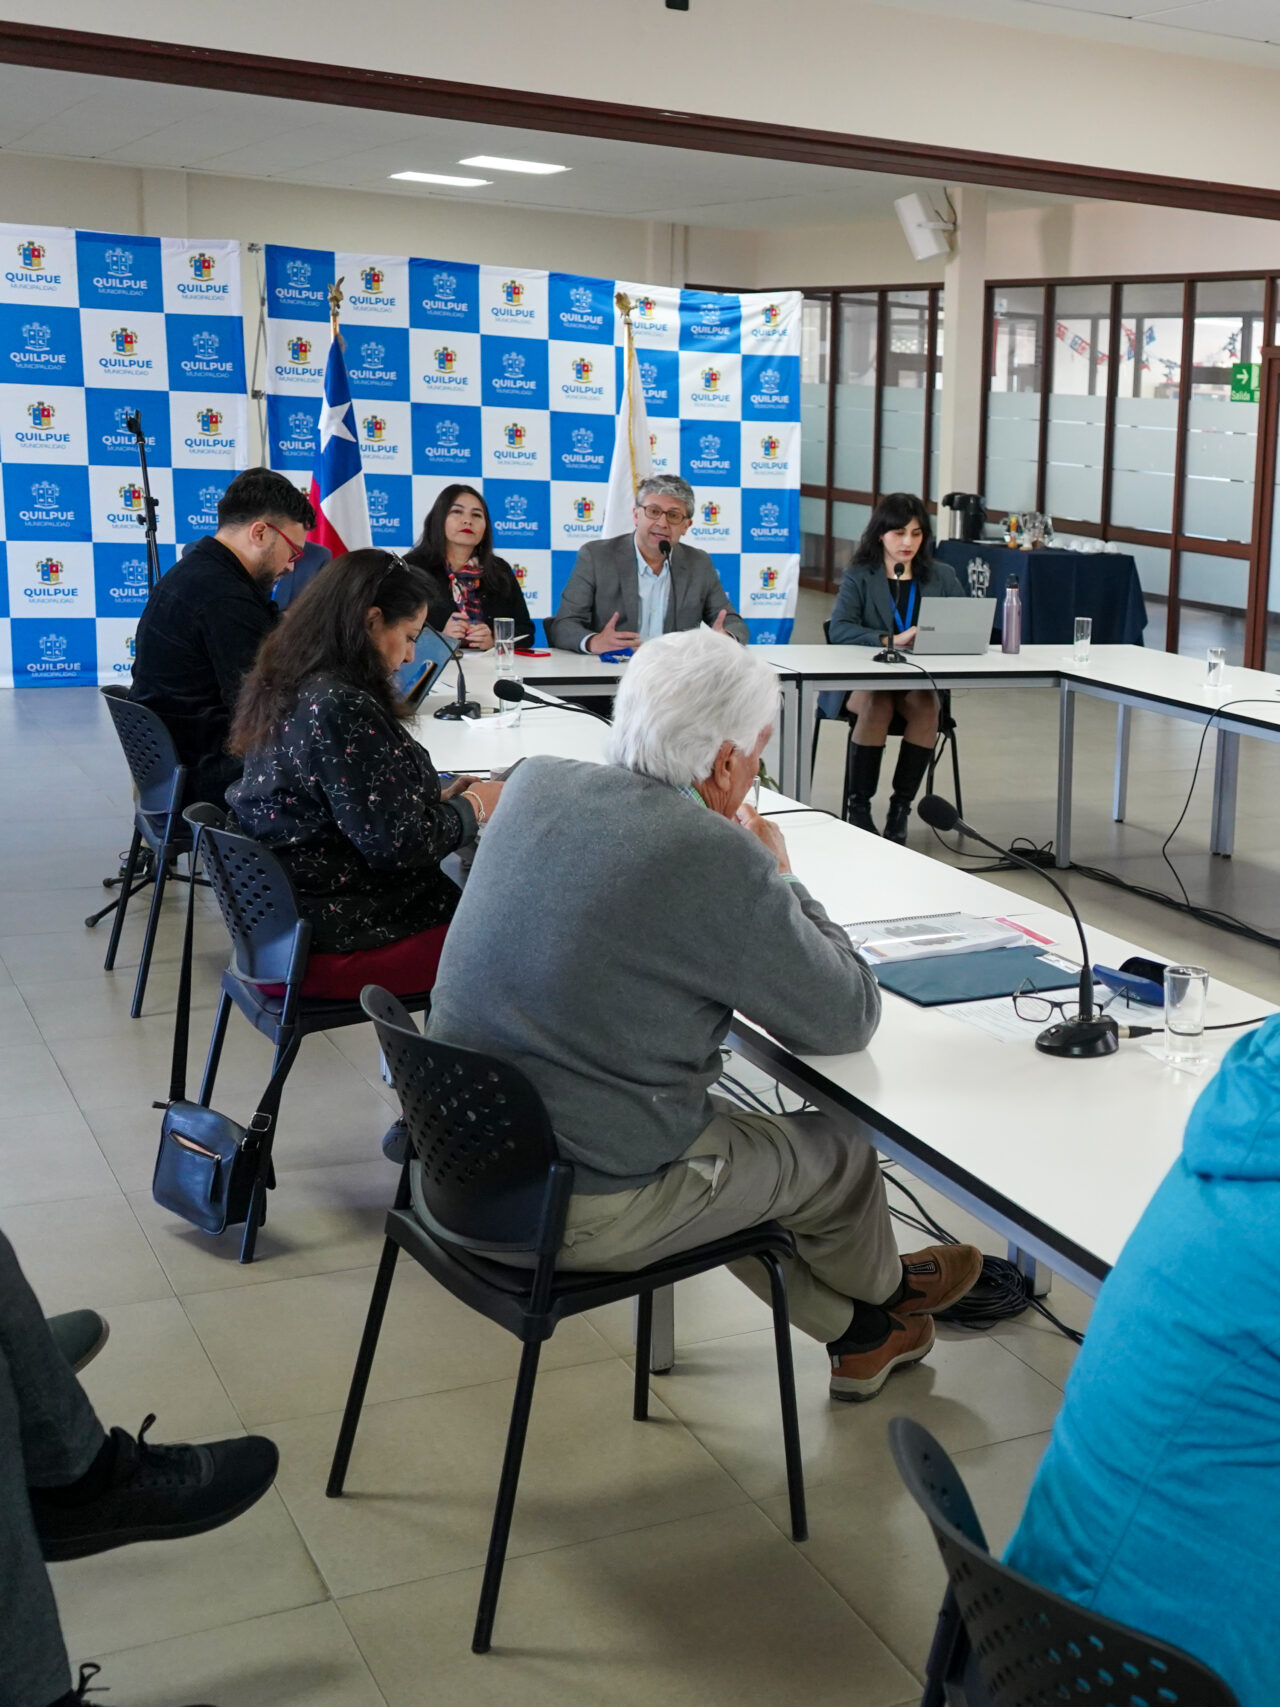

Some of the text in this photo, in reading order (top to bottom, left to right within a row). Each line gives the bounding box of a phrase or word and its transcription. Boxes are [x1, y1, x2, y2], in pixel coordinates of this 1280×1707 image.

[279, 441, 316, 450] QUILP
[188, 515, 218, 524] QUIL
[110, 588, 148, 598] QUILP
